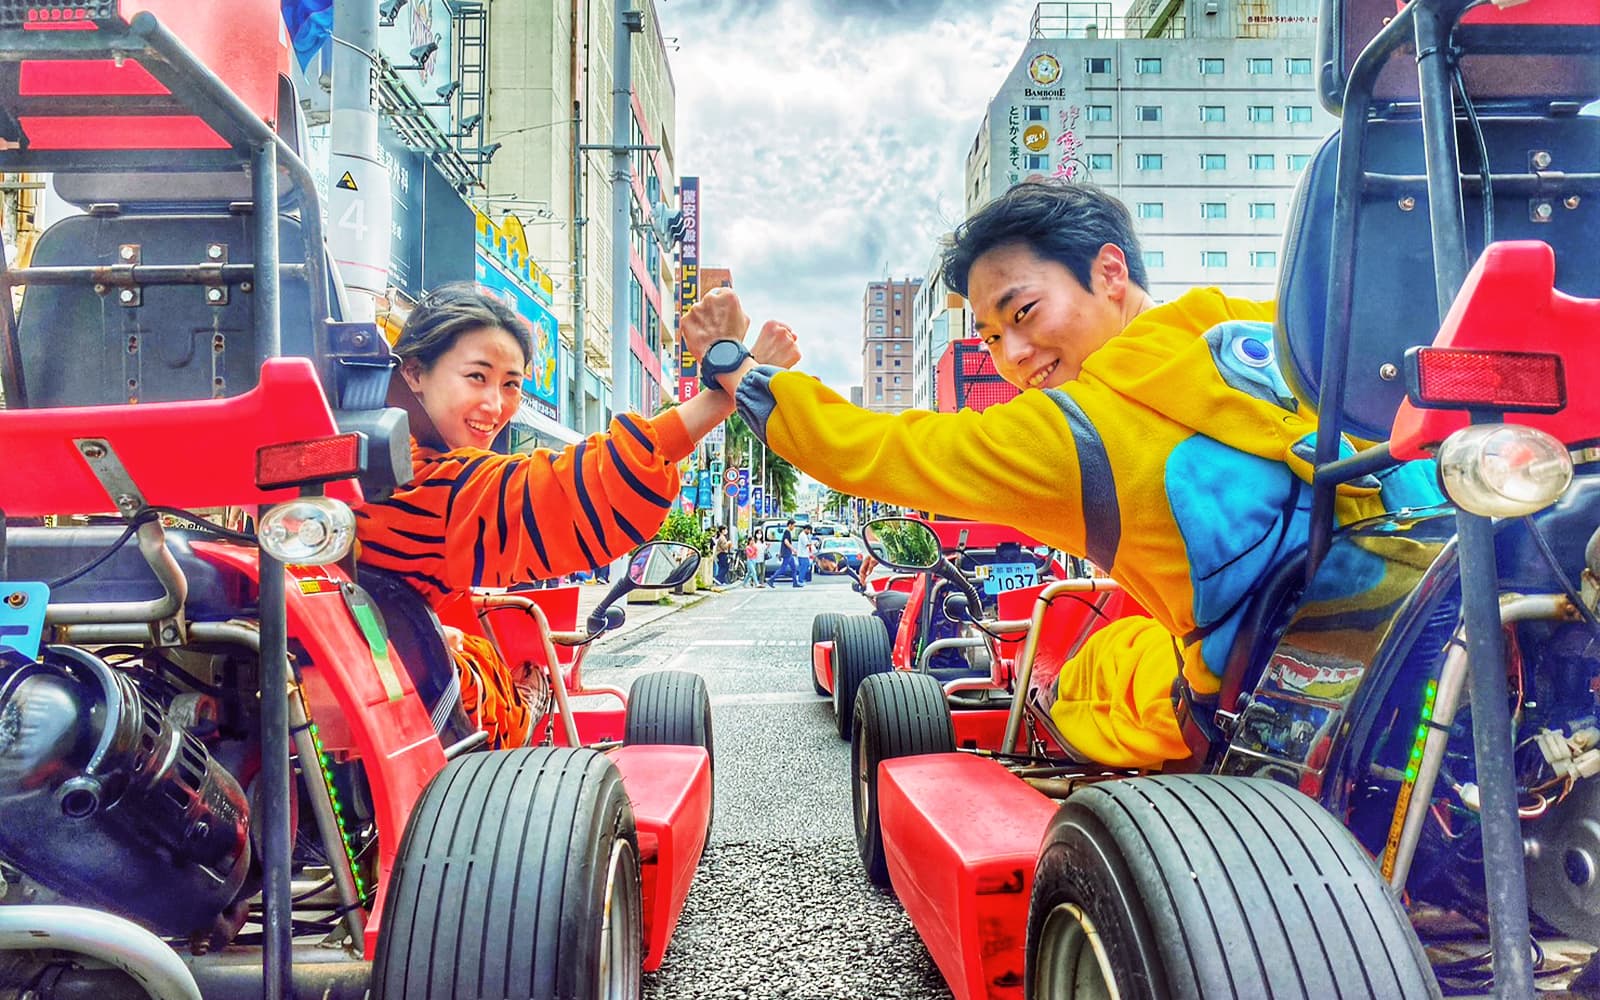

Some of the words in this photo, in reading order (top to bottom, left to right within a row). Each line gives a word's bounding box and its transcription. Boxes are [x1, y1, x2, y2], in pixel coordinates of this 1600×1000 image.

[1024, 88, 1066, 97] BAMBOHE
[337, 198, 369, 242] 4
[998, 574, 1034, 591] 1037
